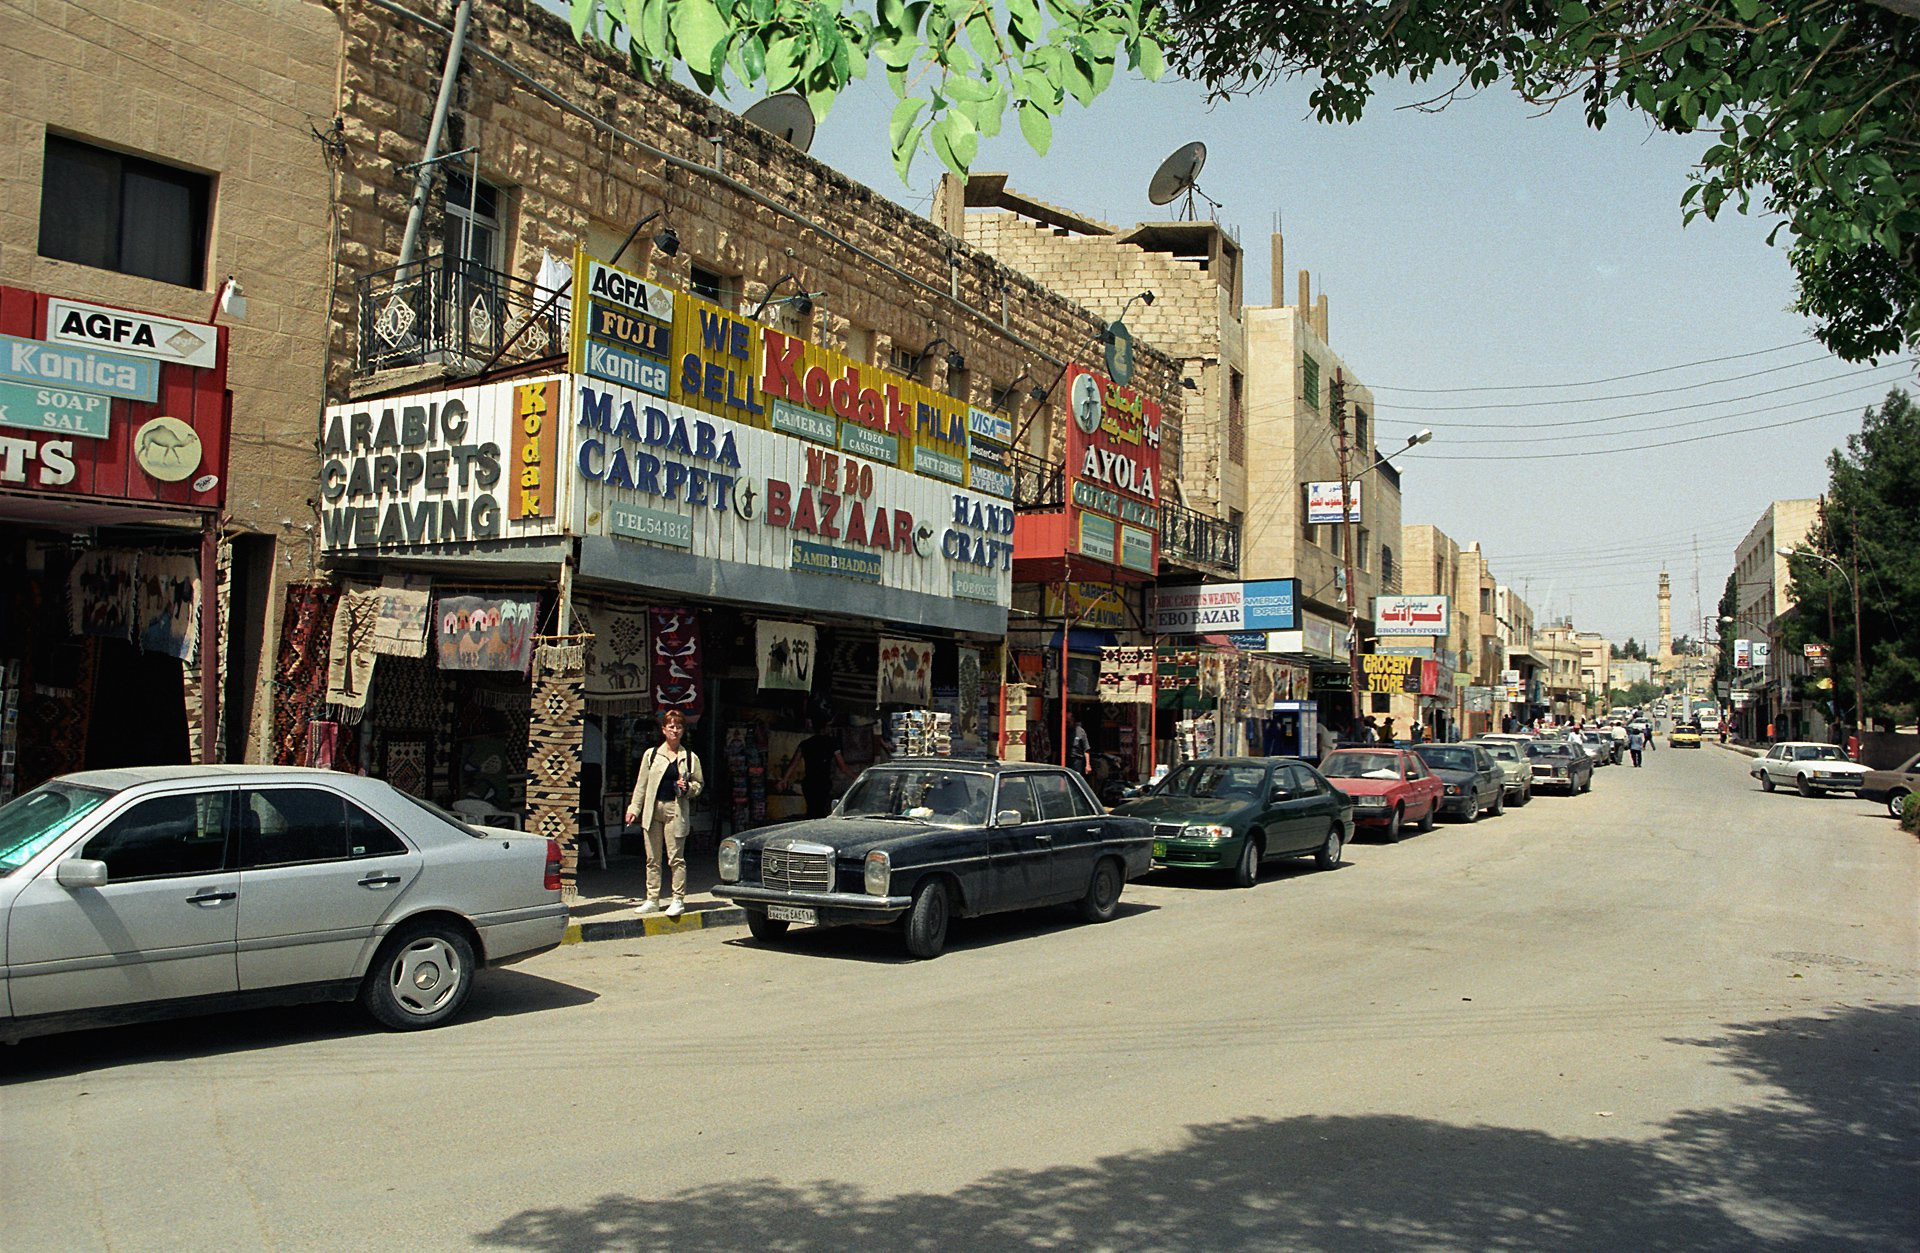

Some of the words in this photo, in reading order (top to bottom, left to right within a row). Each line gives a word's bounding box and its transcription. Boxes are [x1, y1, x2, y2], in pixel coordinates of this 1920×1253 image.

[592, 267, 649, 312] AGFA
[60, 311, 156, 348] AGFA
[601, 310, 657, 349] FUJI
[699, 309, 750, 361] WE
[12, 343, 136, 391] Konica
[590, 344, 666, 392] Konica
[681, 353, 764, 415] SELL
[761, 327, 912, 439] Kodak
[37, 391, 99, 412] SOAP
[42, 412, 88, 431] SAL
[325, 399, 468, 454] ARABIC
[577, 386, 741, 468] MADABA
[776, 408, 832, 438] CAMERAS
[857, 428, 884, 445] VIDEO
[915, 401, 966, 446] FILM
[971, 411, 996, 437] VISA
[519, 382, 547, 517] Kodak
[850, 436, 891, 460] CASSETTE
[918, 454, 962, 479] BATTERIES
[322, 442, 501, 501] CARPETS
[577, 438, 734, 511] CARPET
[1082, 444, 1155, 500] AYOLA
[322, 494, 501, 547] WEAVING
[764, 478, 914, 555] BAZAAR
[952, 494, 1015, 536] HAND
[793, 545, 830, 567] SAMIR
[838, 557, 881, 575] HADDAD
[941, 529, 1014, 571] CRAFT
[1192, 609, 1240, 624] BAZAR
[1208, 592, 1241, 605] WEAVING
[1244, 595, 1290, 607] AMERICAN
[1253, 606, 1293, 616] EXPRESS
[1363, 655, 1413, 675] GROCERY
[1368, 674, 1405, 692] STORE
